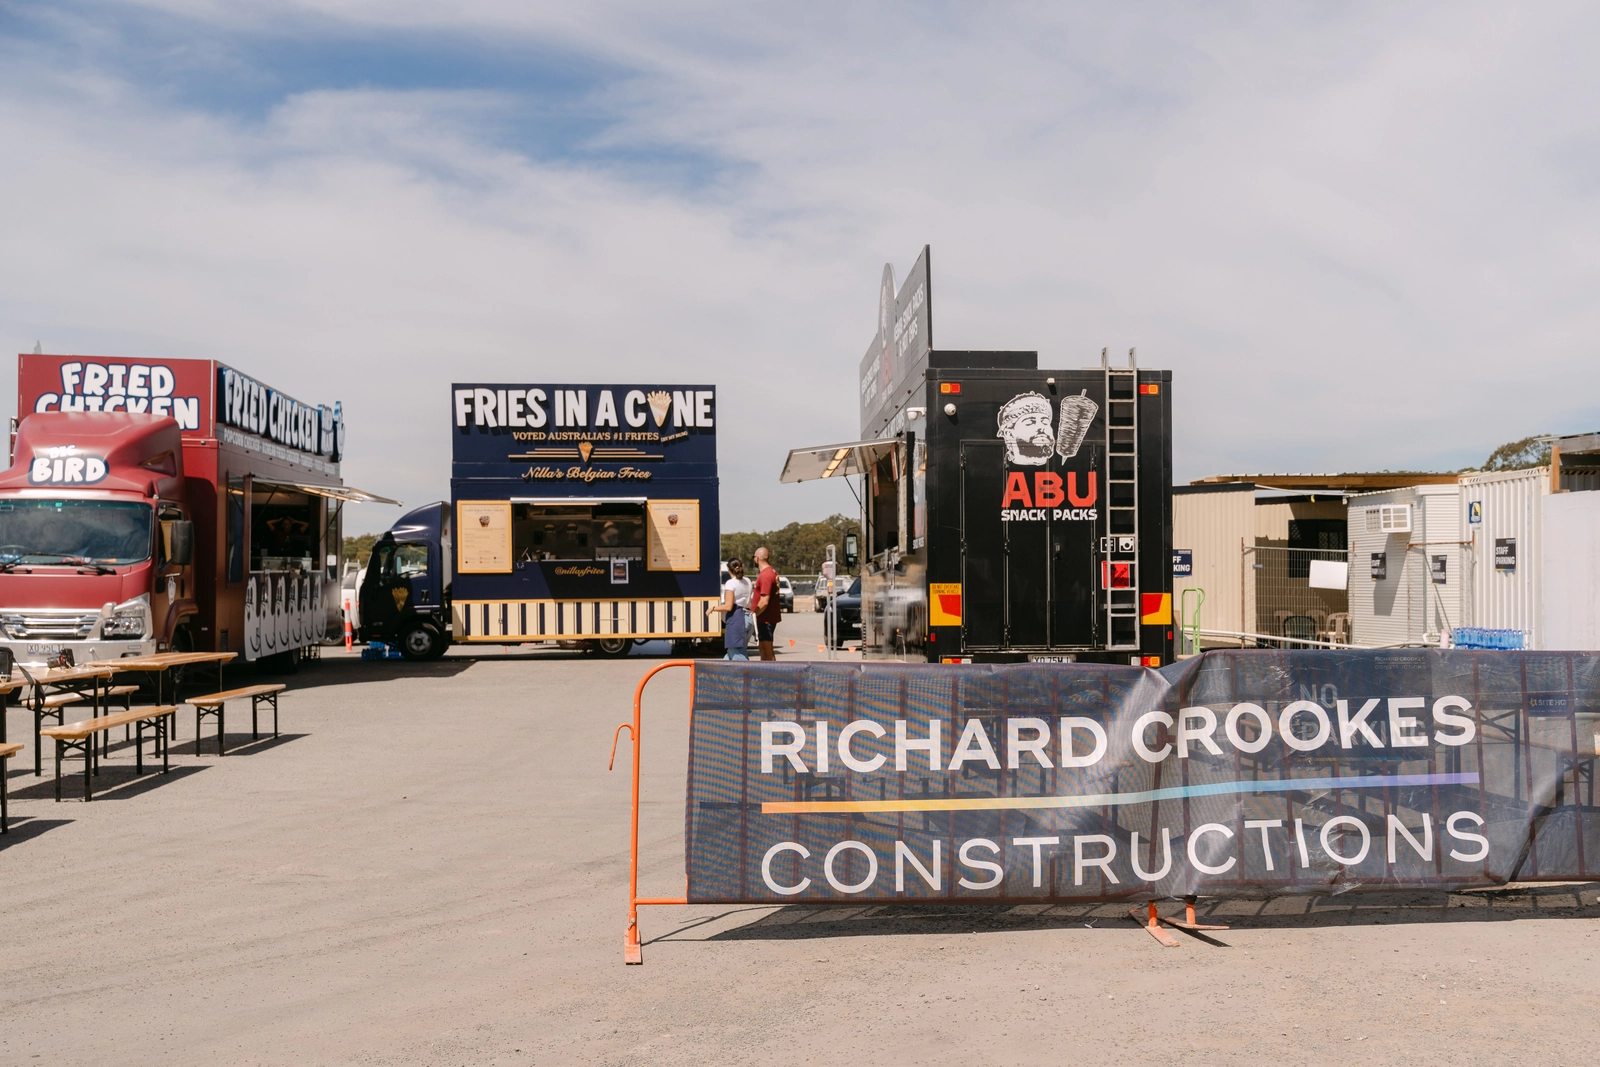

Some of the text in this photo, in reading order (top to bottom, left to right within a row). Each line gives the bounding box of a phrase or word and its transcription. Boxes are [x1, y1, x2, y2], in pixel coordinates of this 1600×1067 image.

[61, 363, 175, 398] FRIED
[224, 369, 318, 454] FRIED CHICKEN
[455, 388, 714, 428] FRIES IN A CNE
[512, 432, 659, 441] VOTED AUSTRALIA'S #1 FRITES
[49, 445, 76, 459] BIG
[32, 457, 106, 483] BIRD
[521, 466, 652, 482] Nilla's Belgian Fries
[1001, 471, 1097, 508] ABU
[1001, 509, 1098, 521] SNACK PACKS
[1495, 546, 1509, 555] STAFF
[1495, 556, 1515, 565] PARKING
[555, 566, 605, 577] @nillasfrites
[1173, 564, 1191, 572] KING
[1300, 684, 1338, 709] NO
[760, 695, 1476, 774] RICHARD CROOKES
[761, 811, 1490, 895] CONSTRUCTIONS
